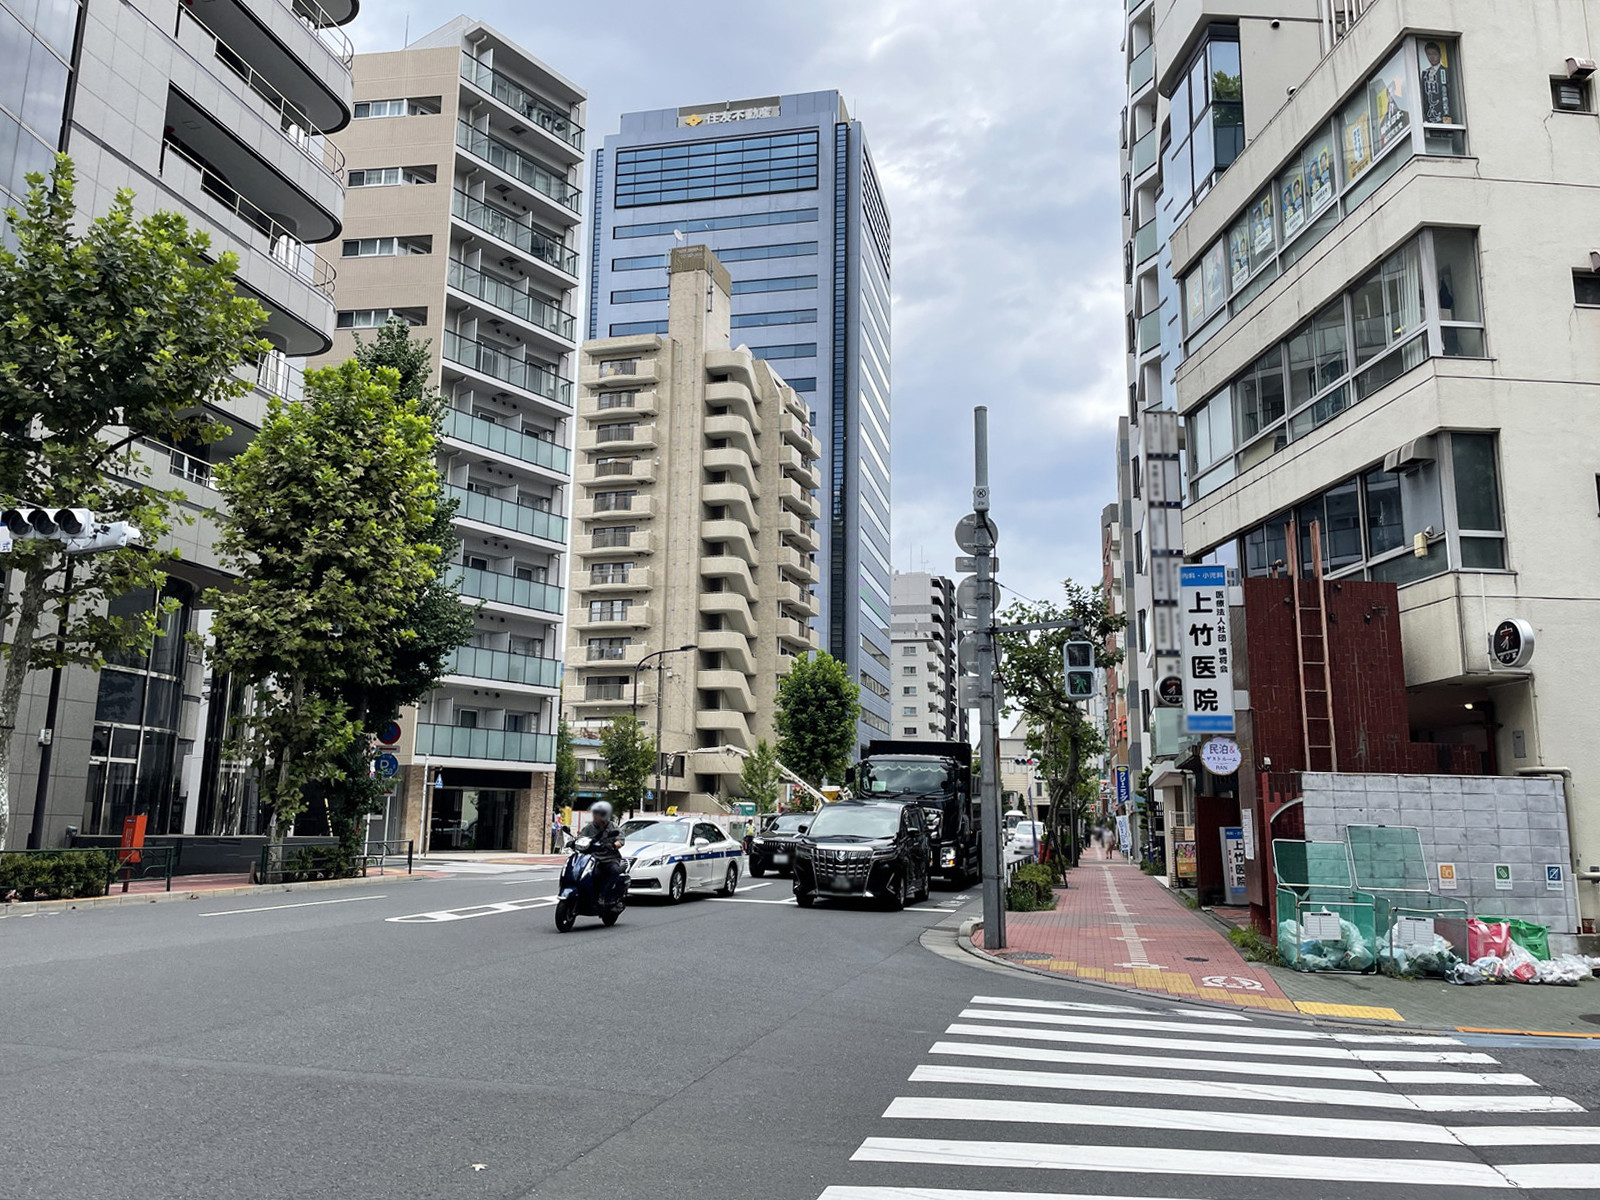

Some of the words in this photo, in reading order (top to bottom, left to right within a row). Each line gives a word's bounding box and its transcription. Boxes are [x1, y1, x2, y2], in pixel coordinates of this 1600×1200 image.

[706, 106, 771, 125] 住友不動産
[1181, 571, 1224, 580] 内科・小児科
[1215, 590, 1227, 642] 医療法人社団
[1188, 591, 1218, 712] 上竹医院
[1209, 743, 1236, 755] 民泊&
[1119, 771, 1129, 802] クリーニング
